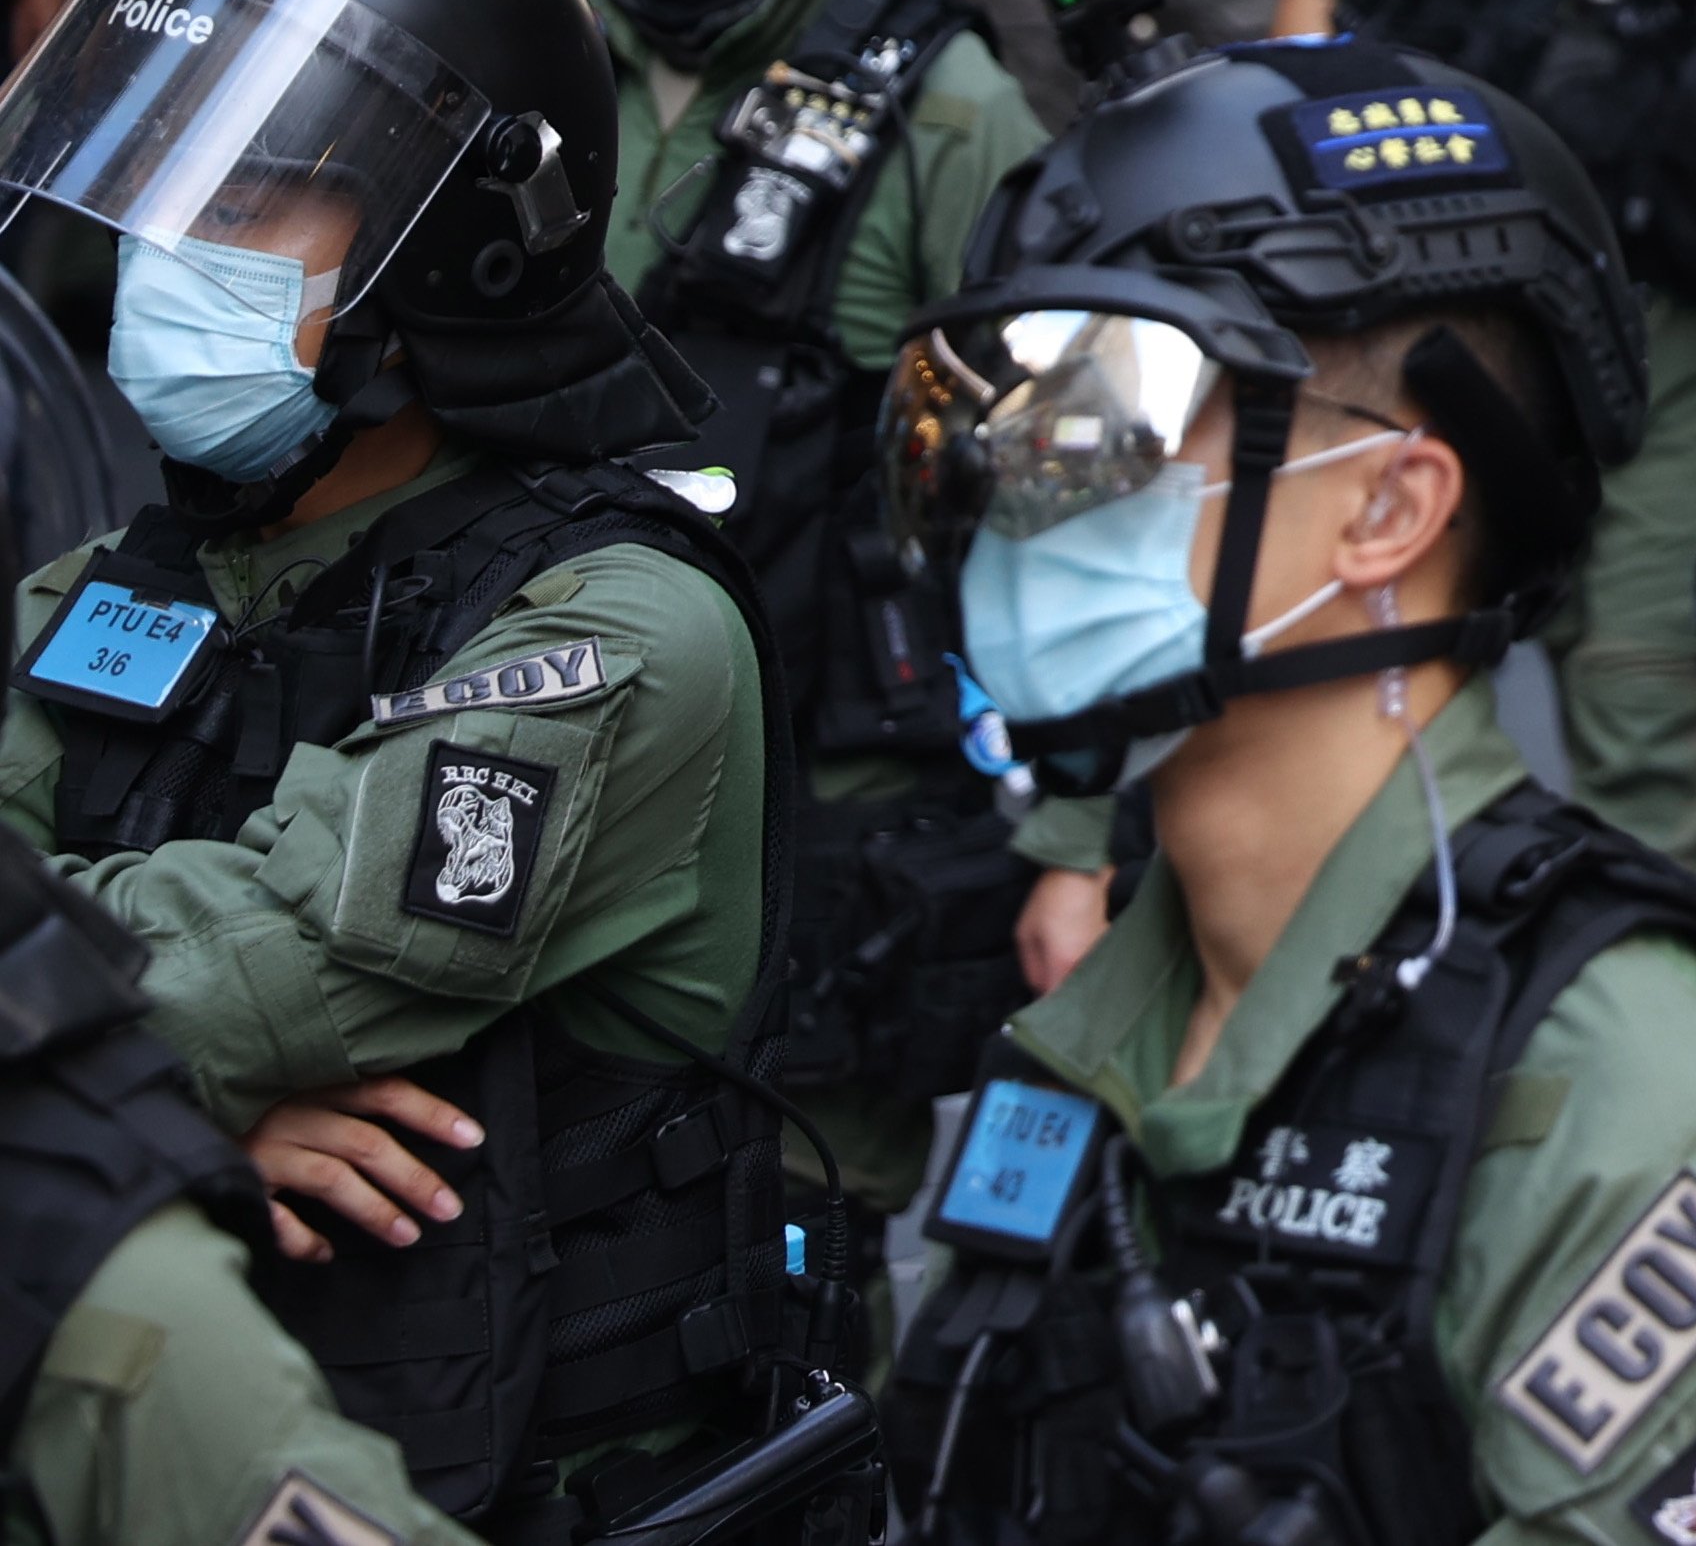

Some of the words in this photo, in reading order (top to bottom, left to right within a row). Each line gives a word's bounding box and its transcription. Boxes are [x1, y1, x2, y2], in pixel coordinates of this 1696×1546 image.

[87, 601, 148, 633] PTU
[146, 614, 186, 643] E4
[88, 647, 131, 676] 3/6
[443, 647, 587, 704] COY
[1216, 1177, 1388, 1247] POLICE
[1524, 1357, 1615, 1444] E
